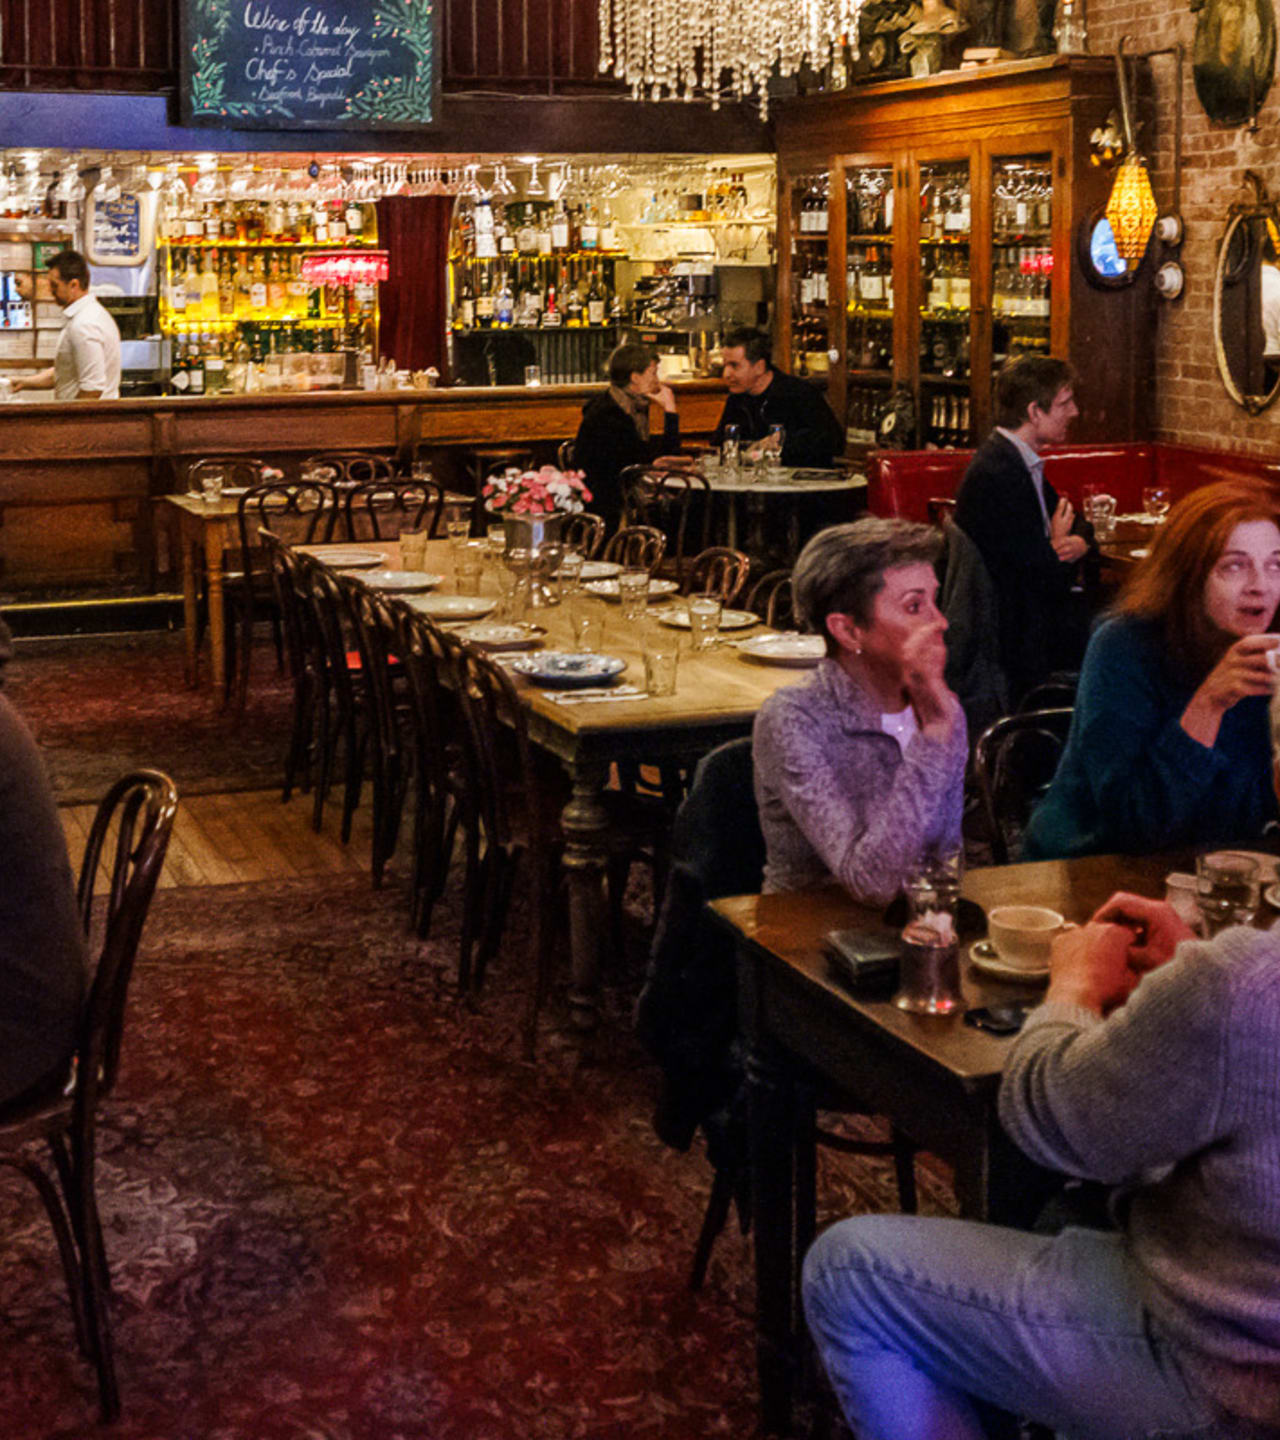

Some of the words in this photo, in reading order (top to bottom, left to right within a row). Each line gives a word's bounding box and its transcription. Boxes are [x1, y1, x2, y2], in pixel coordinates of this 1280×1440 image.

[244, 2, 290, 33] Wine
[293, 7, 312, 36] of
[310, 11, 330, 35] the
[333, 15, 361, 47] day
